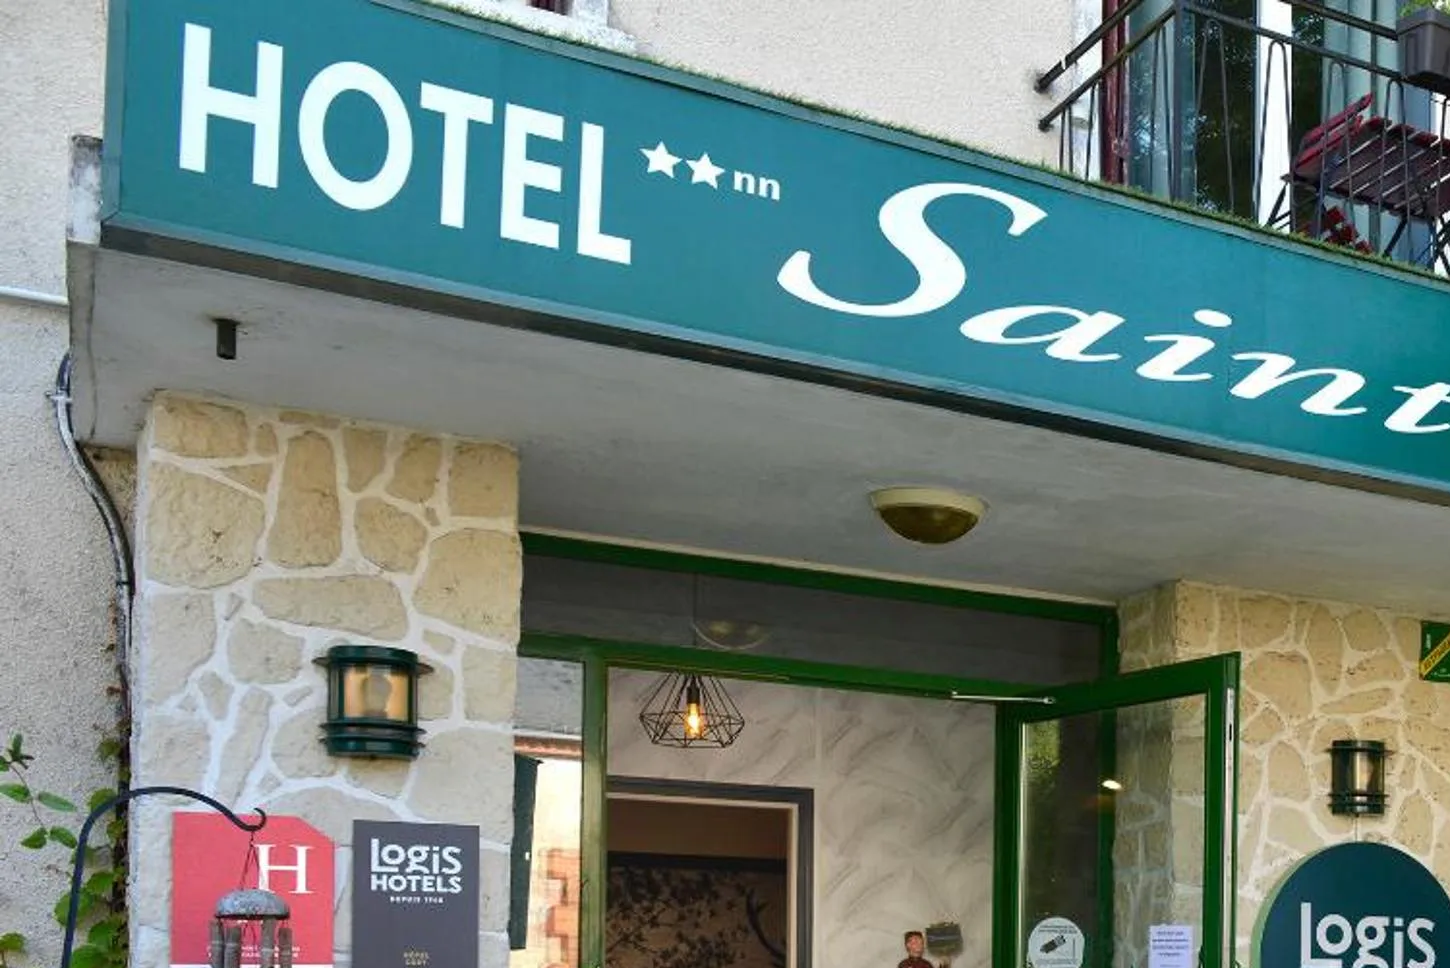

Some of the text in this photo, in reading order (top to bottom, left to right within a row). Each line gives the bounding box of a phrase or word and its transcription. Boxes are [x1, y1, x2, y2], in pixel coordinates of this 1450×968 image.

[179, 22, 632, 266] HOTEL
[734, 170, 780, 201] nn
[253, 843, 314, 894] H
[370, 873, 463, 894] HOTELS
